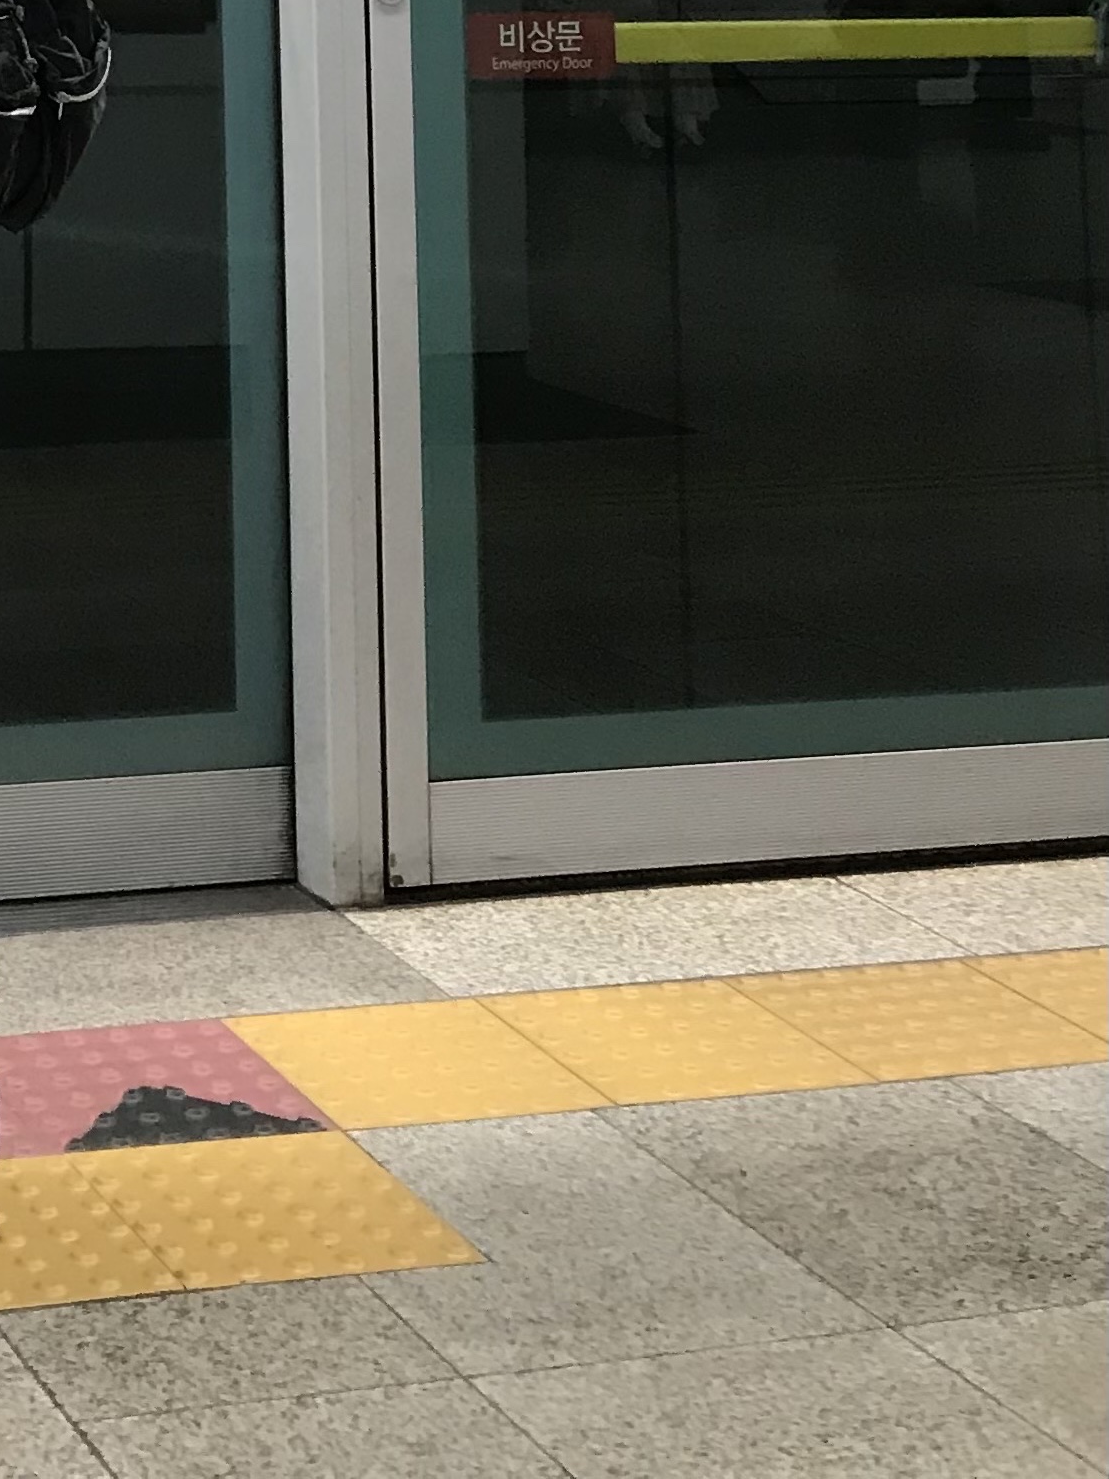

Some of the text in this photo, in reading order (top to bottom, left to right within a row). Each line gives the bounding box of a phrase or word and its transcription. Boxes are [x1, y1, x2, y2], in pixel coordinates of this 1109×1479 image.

[498, 20, 584, 53] 비상문
[492, 56, 593, 73] Emergency Door
